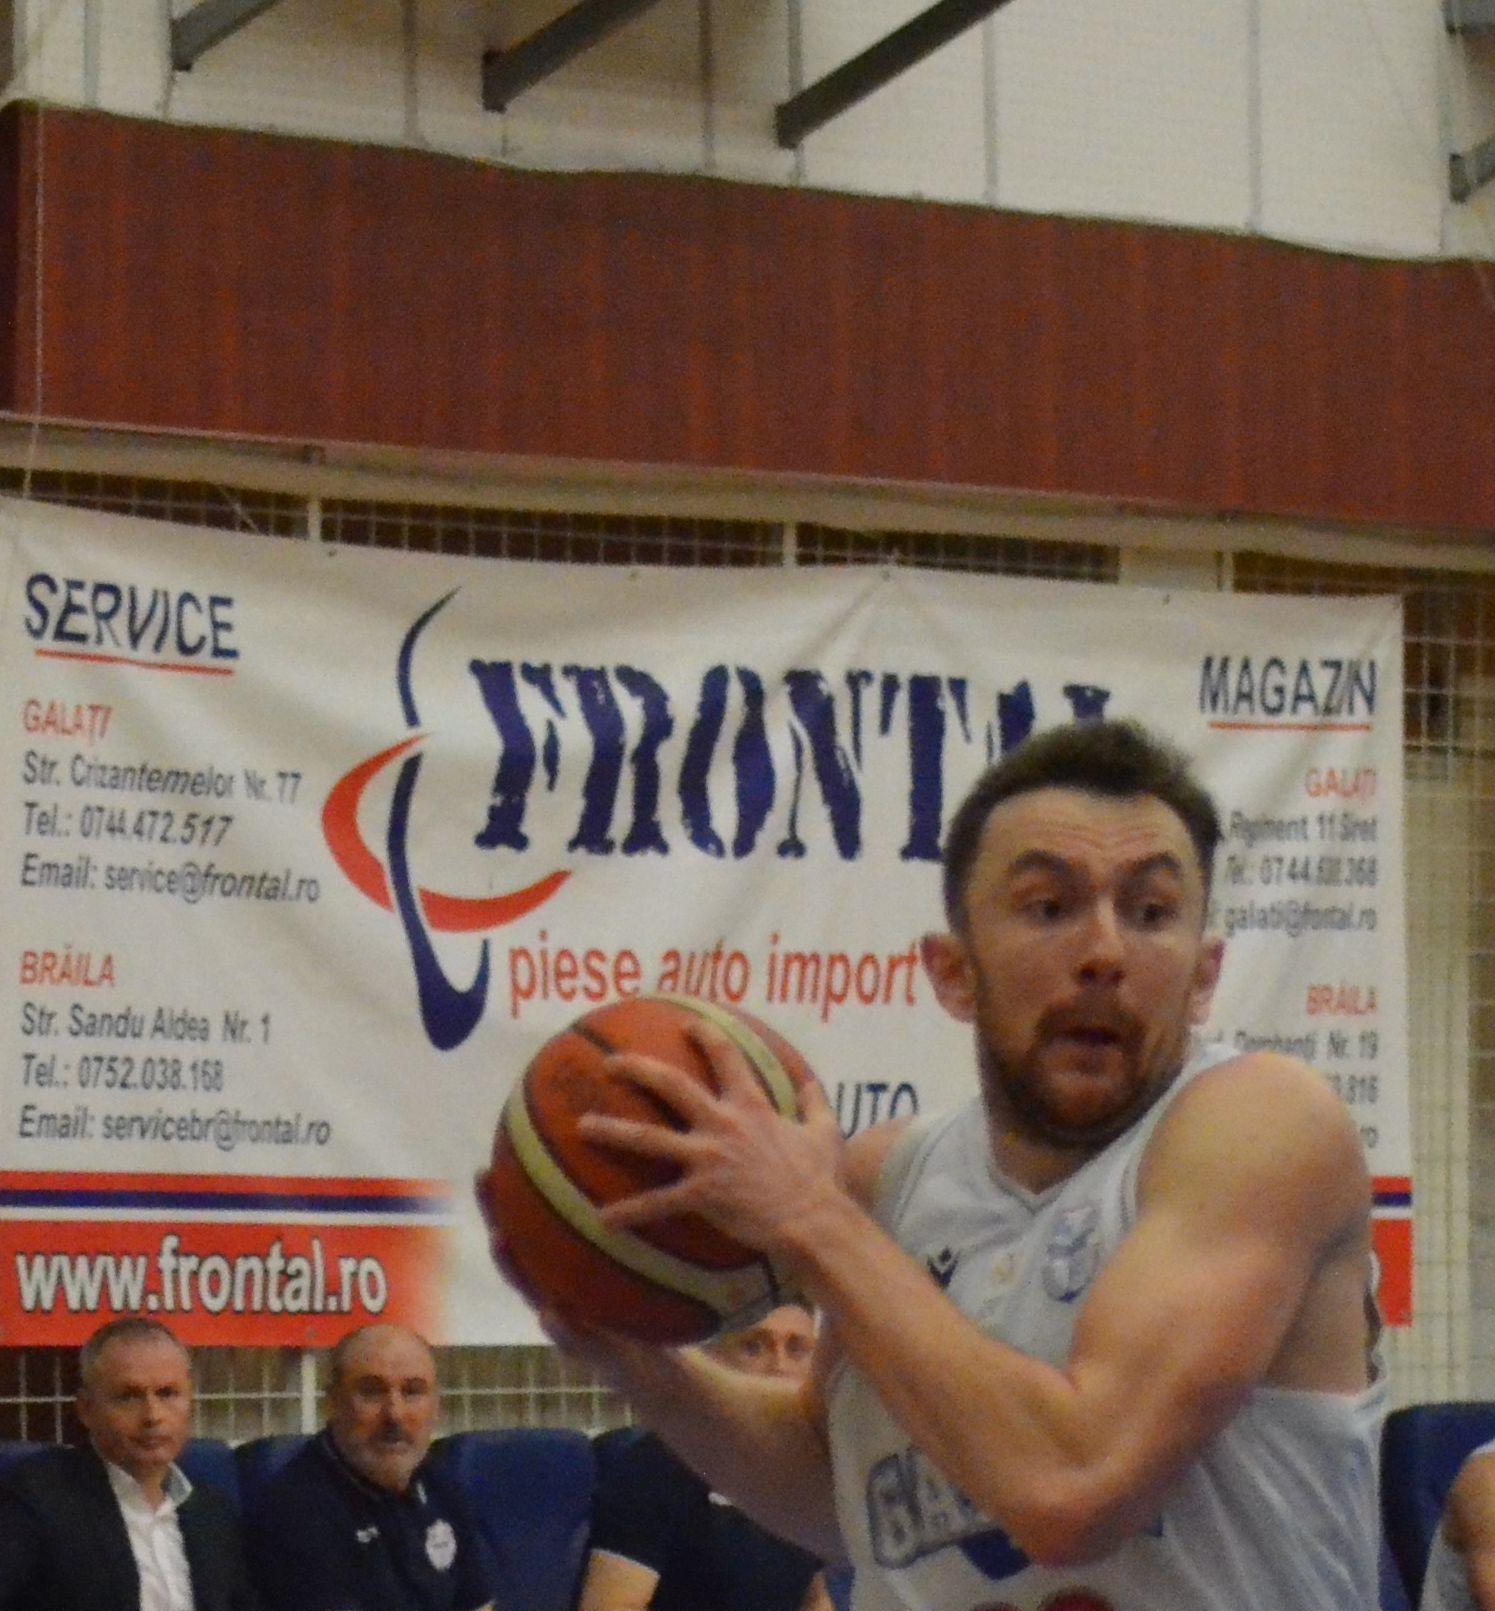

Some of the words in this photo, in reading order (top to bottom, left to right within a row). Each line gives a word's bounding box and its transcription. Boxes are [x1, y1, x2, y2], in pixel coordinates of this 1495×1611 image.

[25, 573, 240, 659] SERVICE
[23, 750, 60, 785] Str.
[469, 657, 1111, 862] FRONT
[104, 861, 320, 903] service@frontal.ro
[509, 931, 641, 1017] piese
[662, 941, 751, 1002] auto
[767, 934, 919, 1020] import
[21, 1003, 59, 1037] Str.
[69, 1003, 144, 1038] Sandu
[261, 1012, 271, 1044] 1
[835, 1082, 919, 1141] UTO
[16, 1232, 388, 1315] www.frontal.ro
